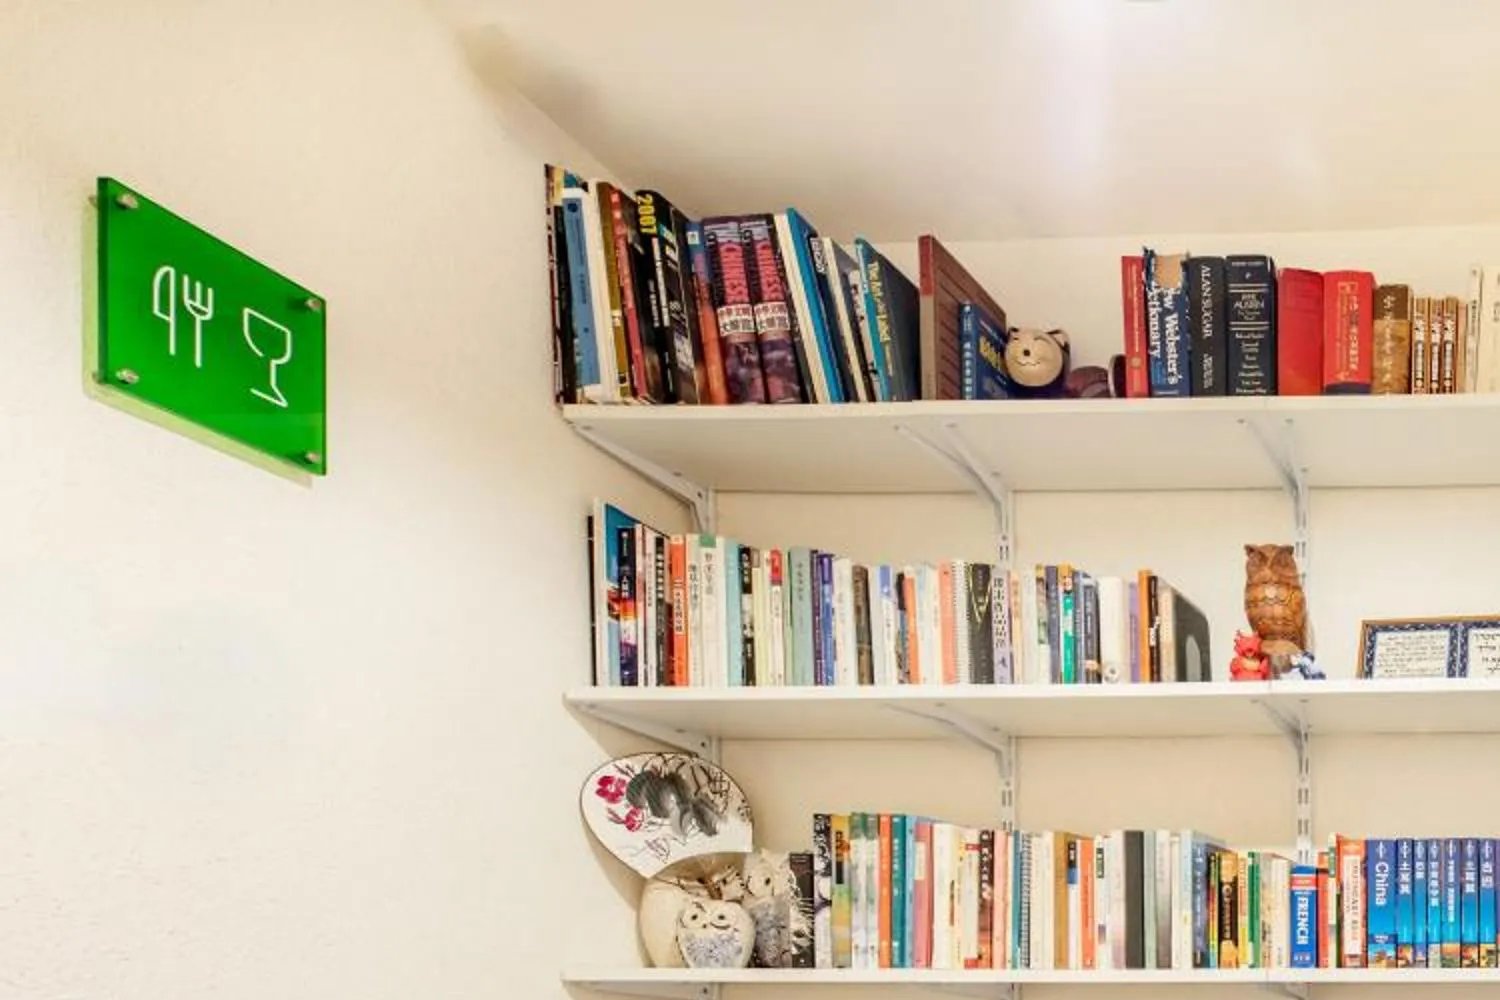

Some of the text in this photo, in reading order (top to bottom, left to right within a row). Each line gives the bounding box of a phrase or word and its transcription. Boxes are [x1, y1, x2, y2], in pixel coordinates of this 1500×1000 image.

[1201, 264, 1213, 297] ALAN
[1201, 298, 1213, 340] SUGAR
[1163, 312, 1183, 385] Webster's
[1375, 861, 1390, 906] China
[1296, 896, 1309, 945] FRENCH
